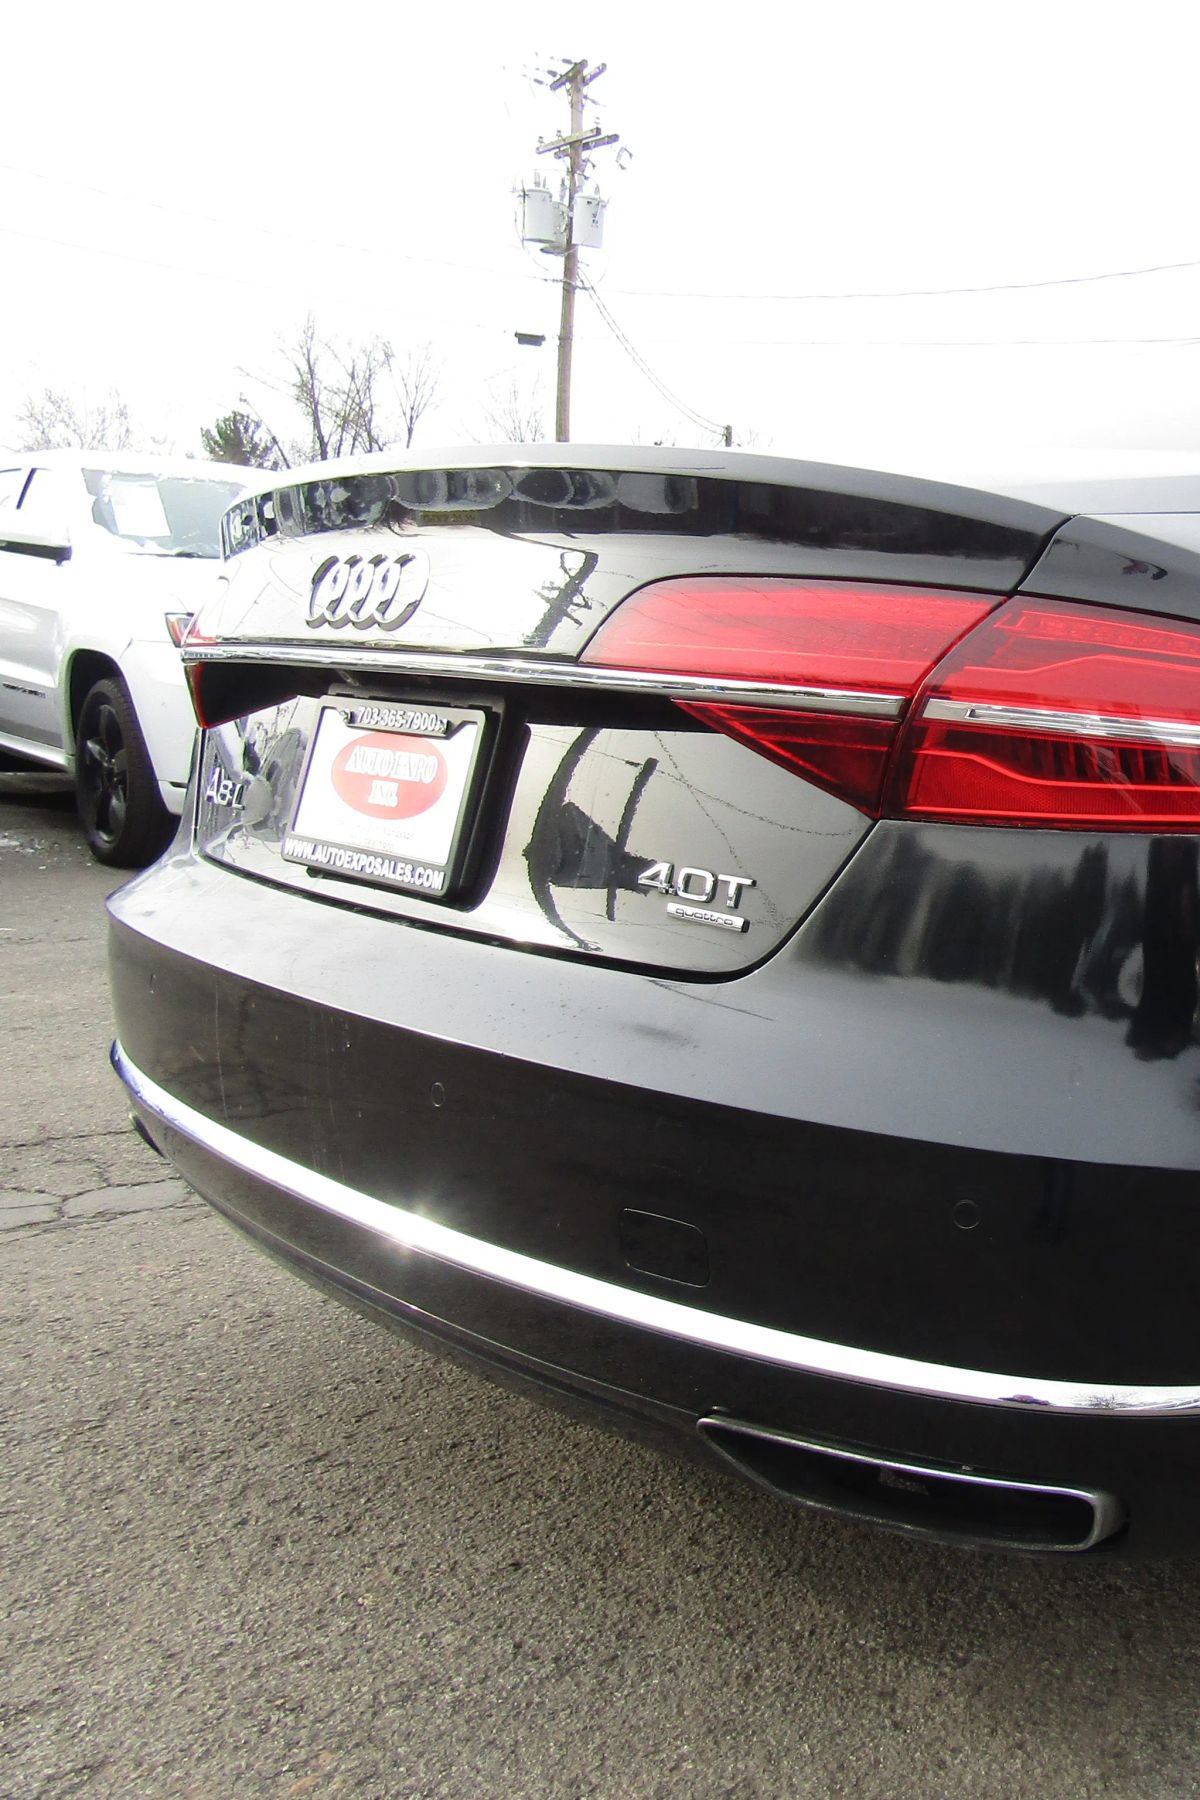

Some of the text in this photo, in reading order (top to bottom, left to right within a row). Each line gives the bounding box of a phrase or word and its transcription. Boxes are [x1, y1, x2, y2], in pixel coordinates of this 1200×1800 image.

[357, 706, 437, 731] 703-365-7900
[204, 767, 247, 811] A8L
[284, 837, 445, 891] WWW.AUTOEXPOSALES.COM
[674, 906, 735, 927] quattro
